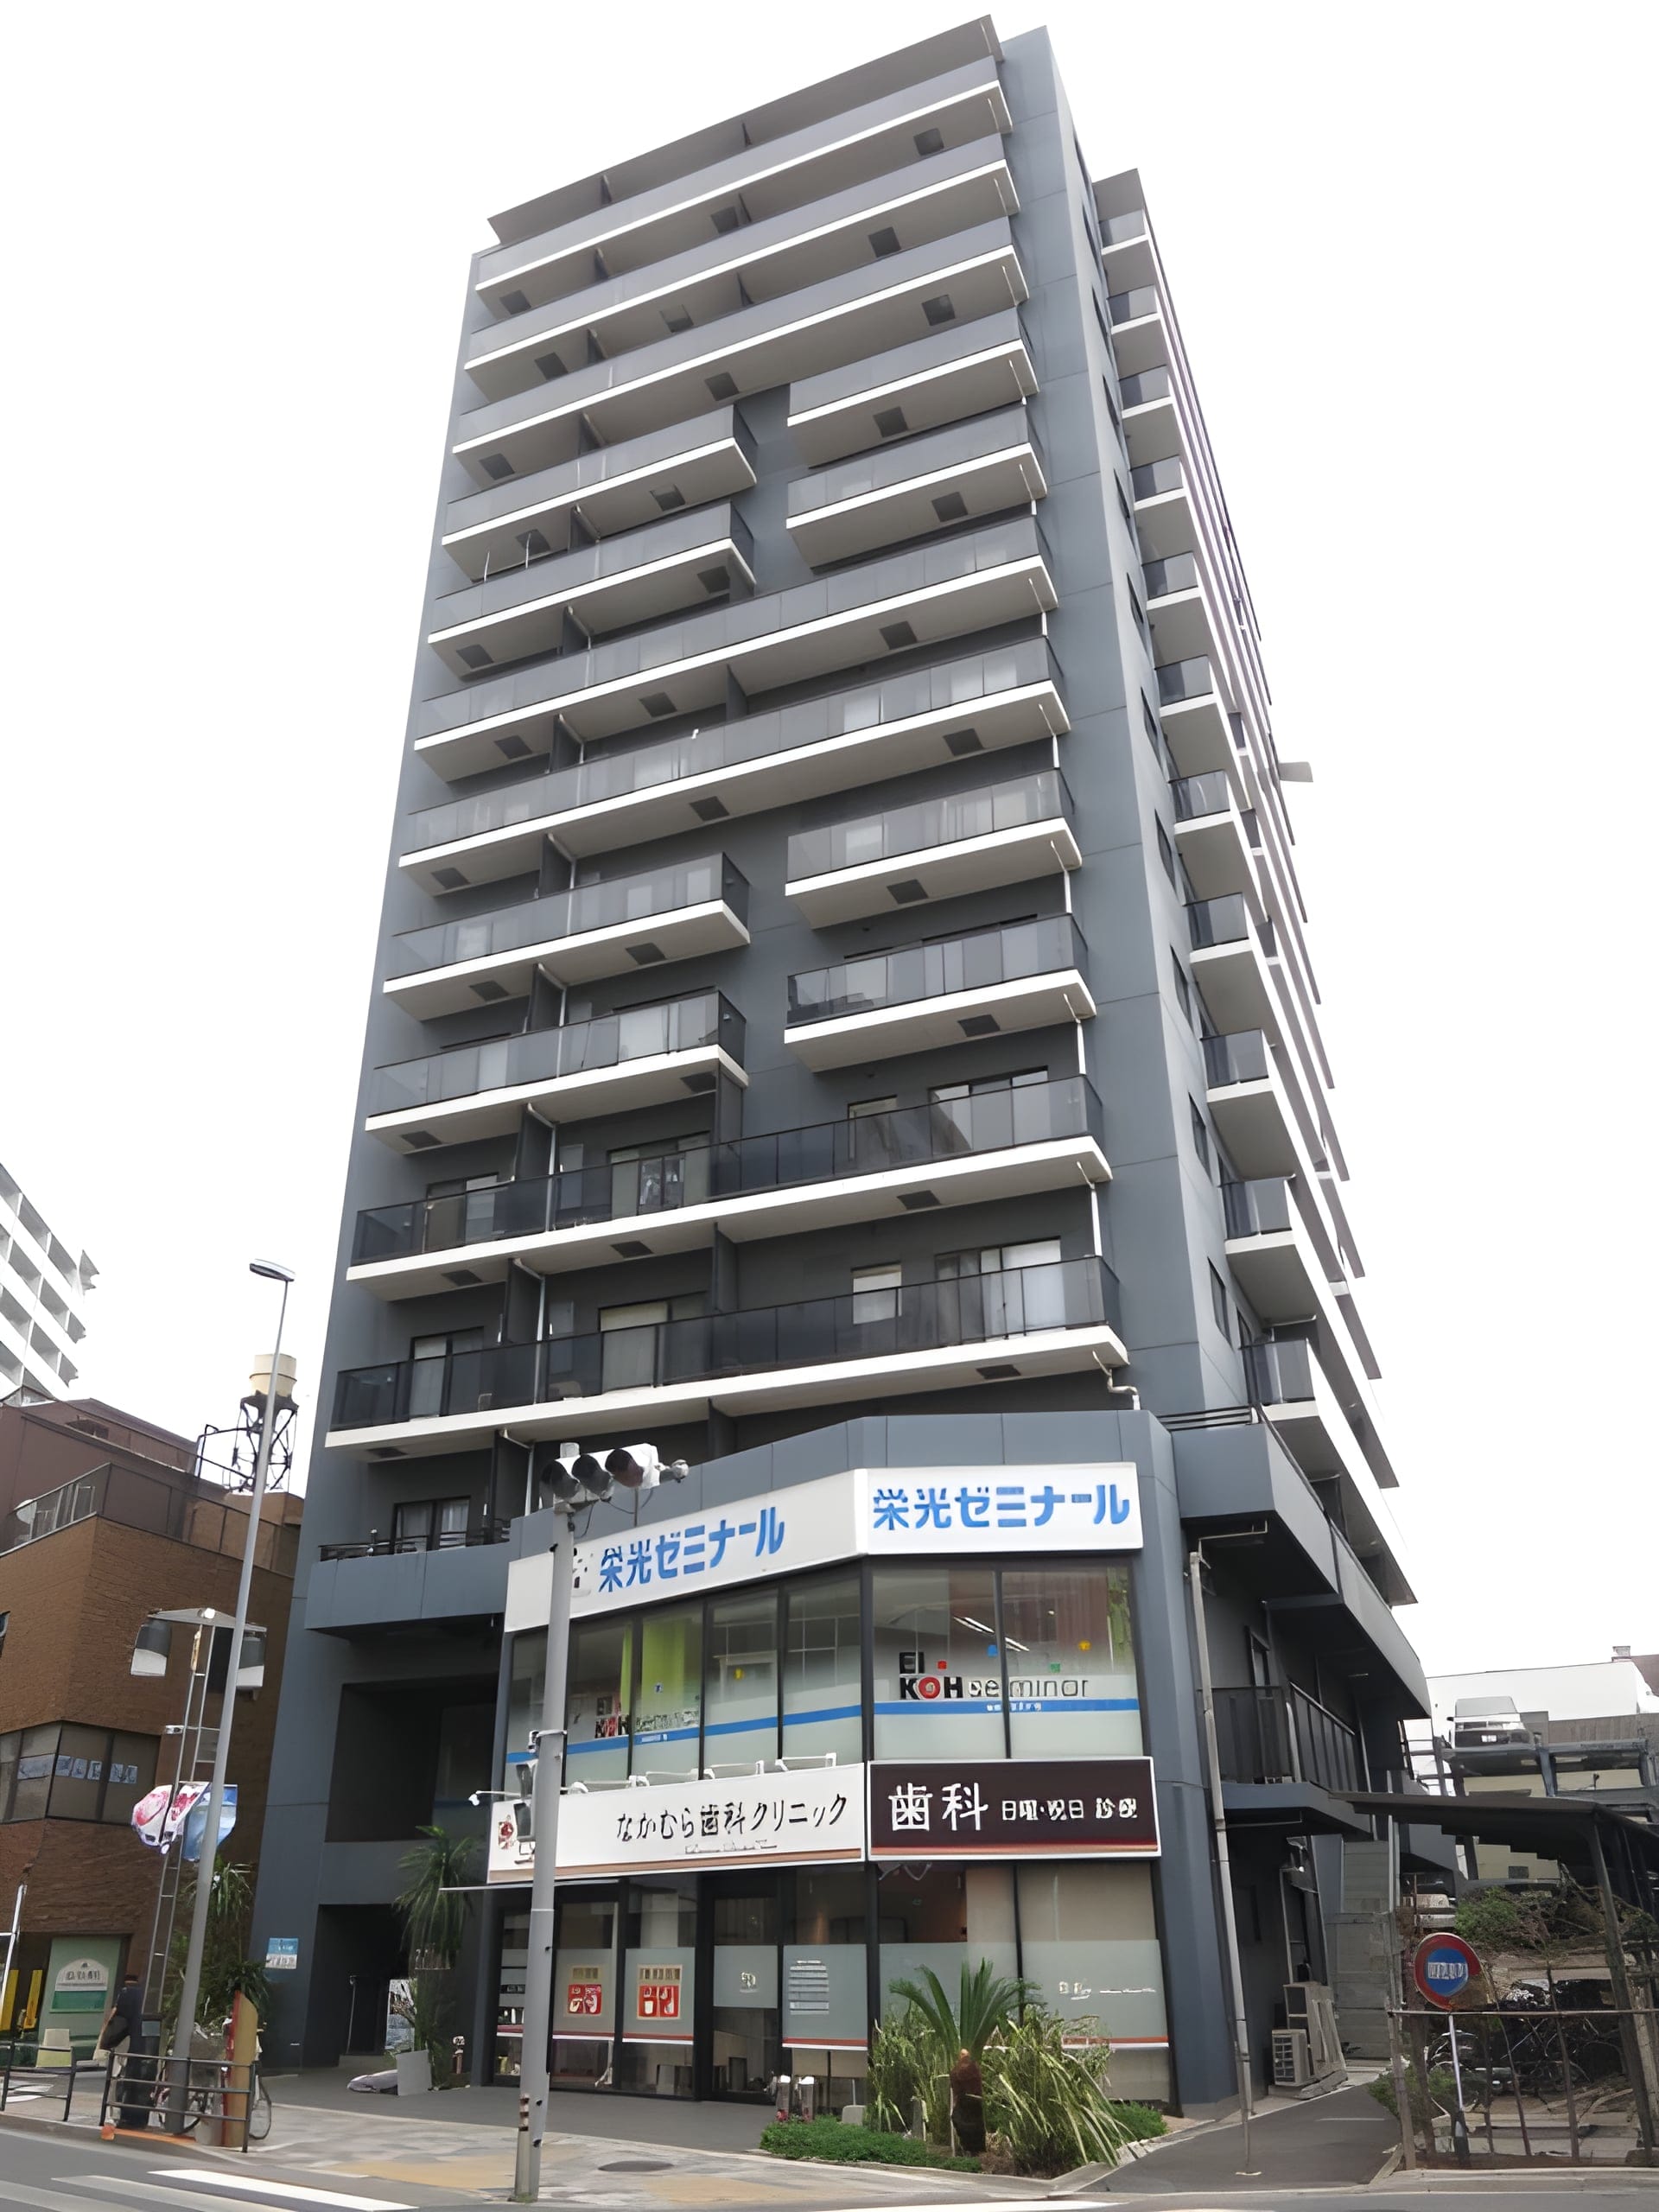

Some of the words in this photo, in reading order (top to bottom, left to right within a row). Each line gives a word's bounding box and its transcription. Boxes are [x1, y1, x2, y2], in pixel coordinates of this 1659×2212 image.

[873, 1484, 1130, 1531] 栄光ゼミナール
[598, 1506, 785, 1592] 栄光ゼミナール
[616, 1793, 848, 1842] なかむら歯科クリニック
[887, 1782, 988, 1831] 歯科
